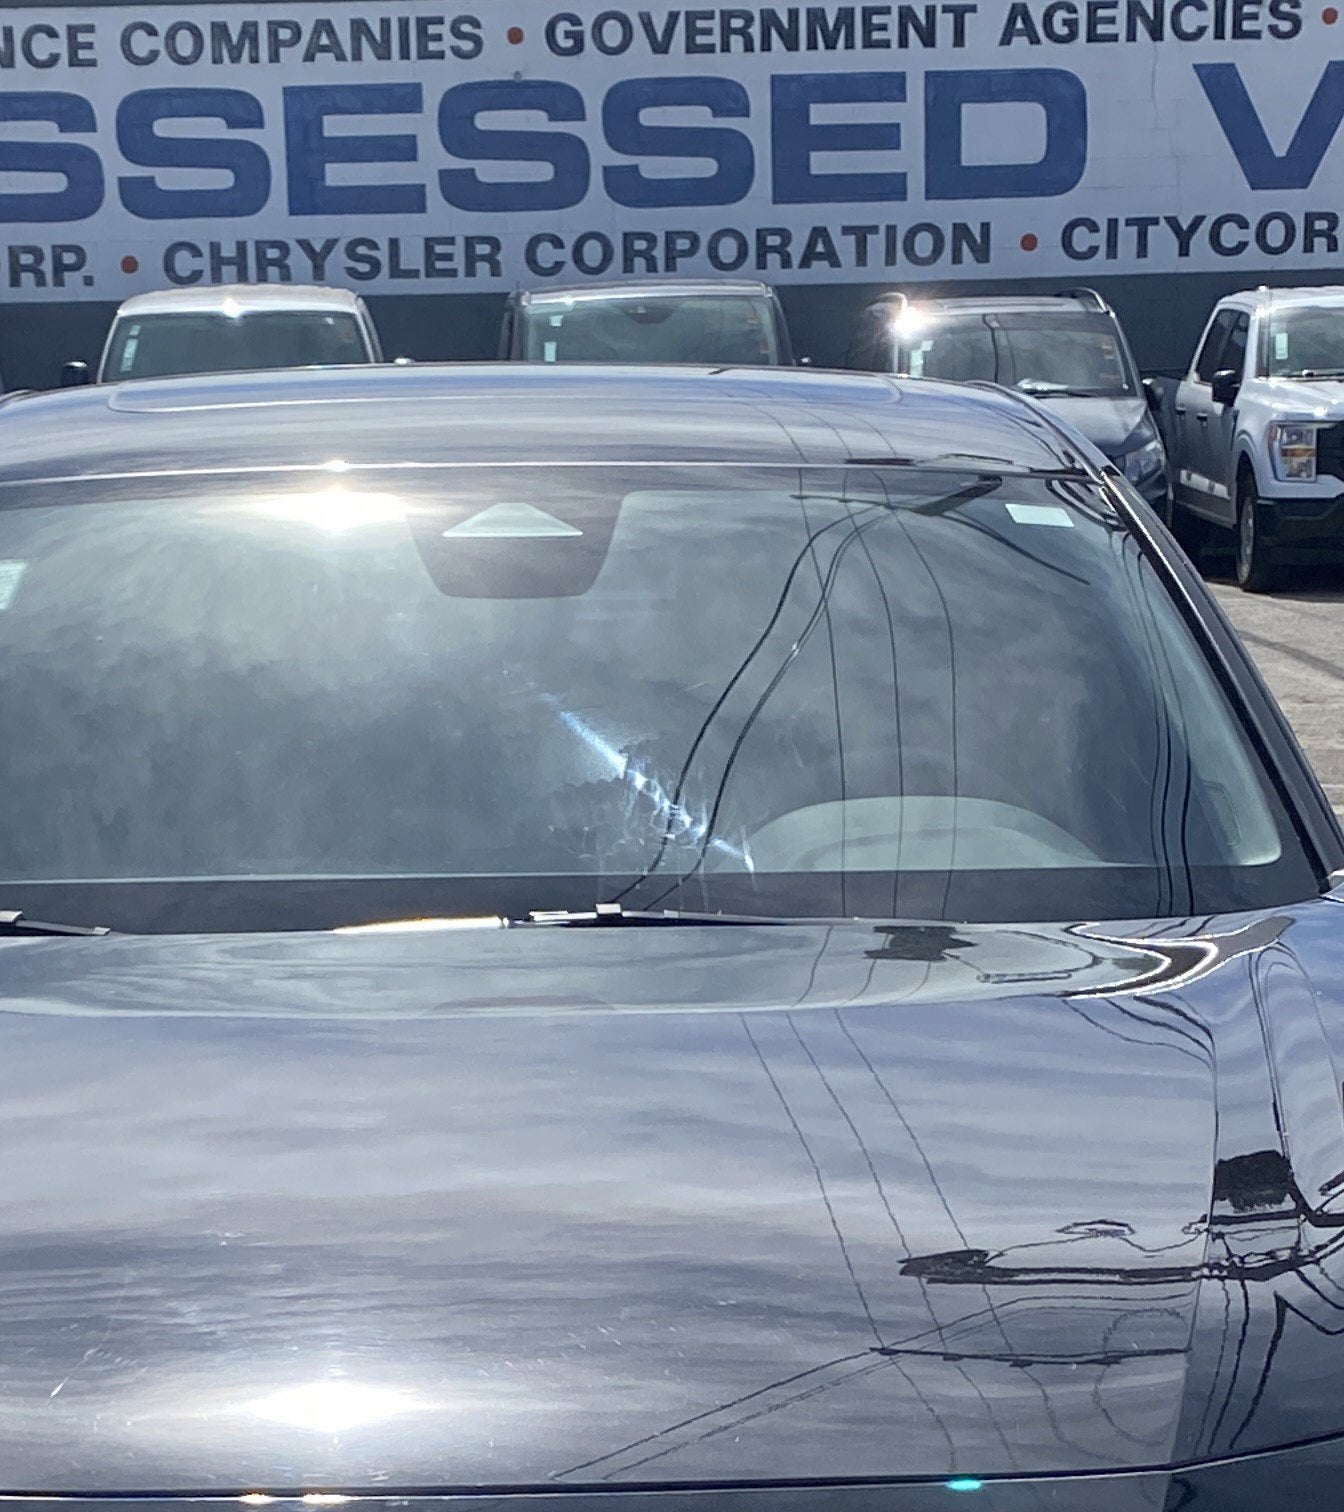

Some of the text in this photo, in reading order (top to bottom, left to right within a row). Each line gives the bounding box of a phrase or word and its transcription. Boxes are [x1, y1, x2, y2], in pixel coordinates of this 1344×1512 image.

[120, 14, 484, 67] COMPANIES
[544, 2, 978, 57] GOVERNMENT
[998, 0, 1303, 47] AGENCIES
[162, 235, 503, 286] CHRYSLER
[524, 222, 992, 277] CORPORATION
